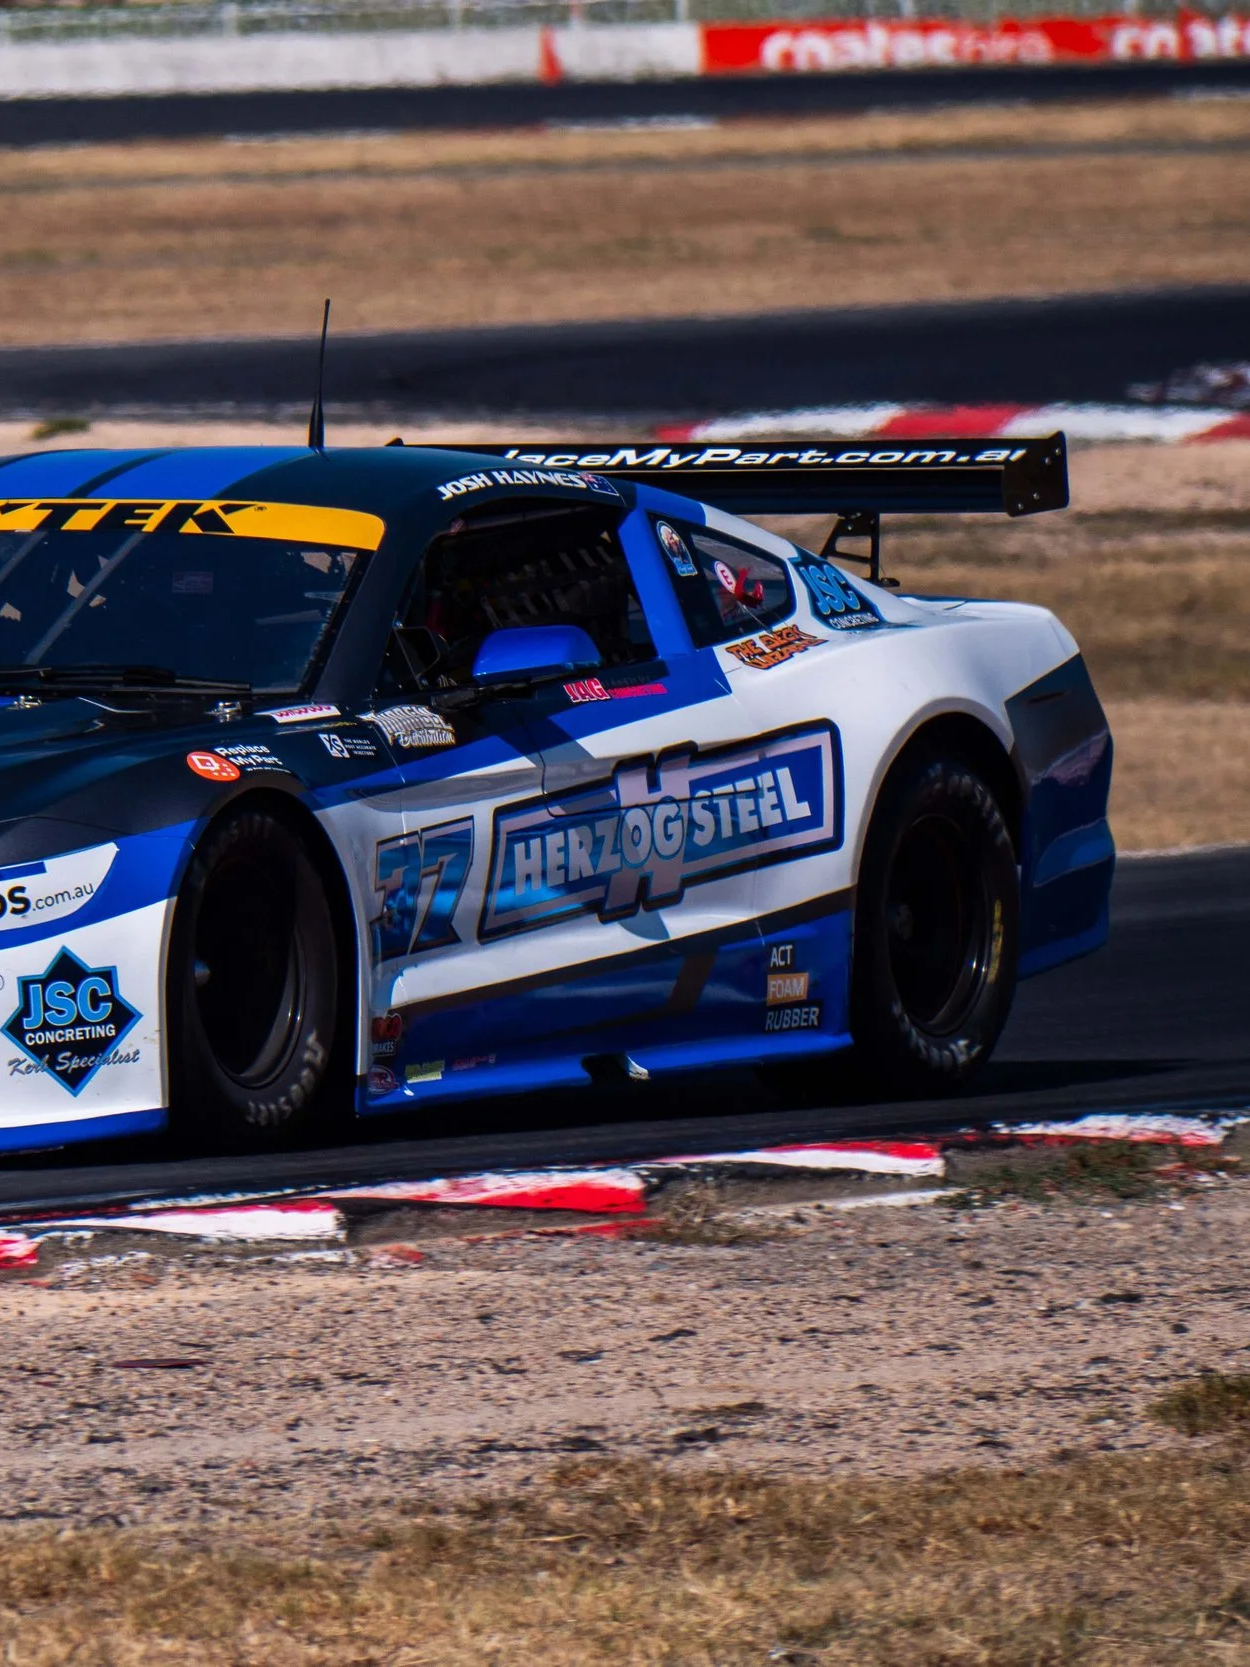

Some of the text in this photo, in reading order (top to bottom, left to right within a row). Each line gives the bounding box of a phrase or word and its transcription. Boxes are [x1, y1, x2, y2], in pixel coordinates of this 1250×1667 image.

[438, 469, 587, 501] JOSH HAYNES
[800, 564, 861, 616] JSC
[828, 612, 879, 630] CONCRETING
[213, 744, 271, 757] Replace
[514, 767, 812, 896] HERZOG STEEL
[770, 944, 793, 968] ACT
[768, 976, 806, 1001] FOAM
[23, 977, 113, 1030] JSC
[765, 1006, 820, 1031] RUBBER
[25, 1024, 116, 1046] CONCRETING
[7, 1048, 140, 1077] Kerb Specialist
